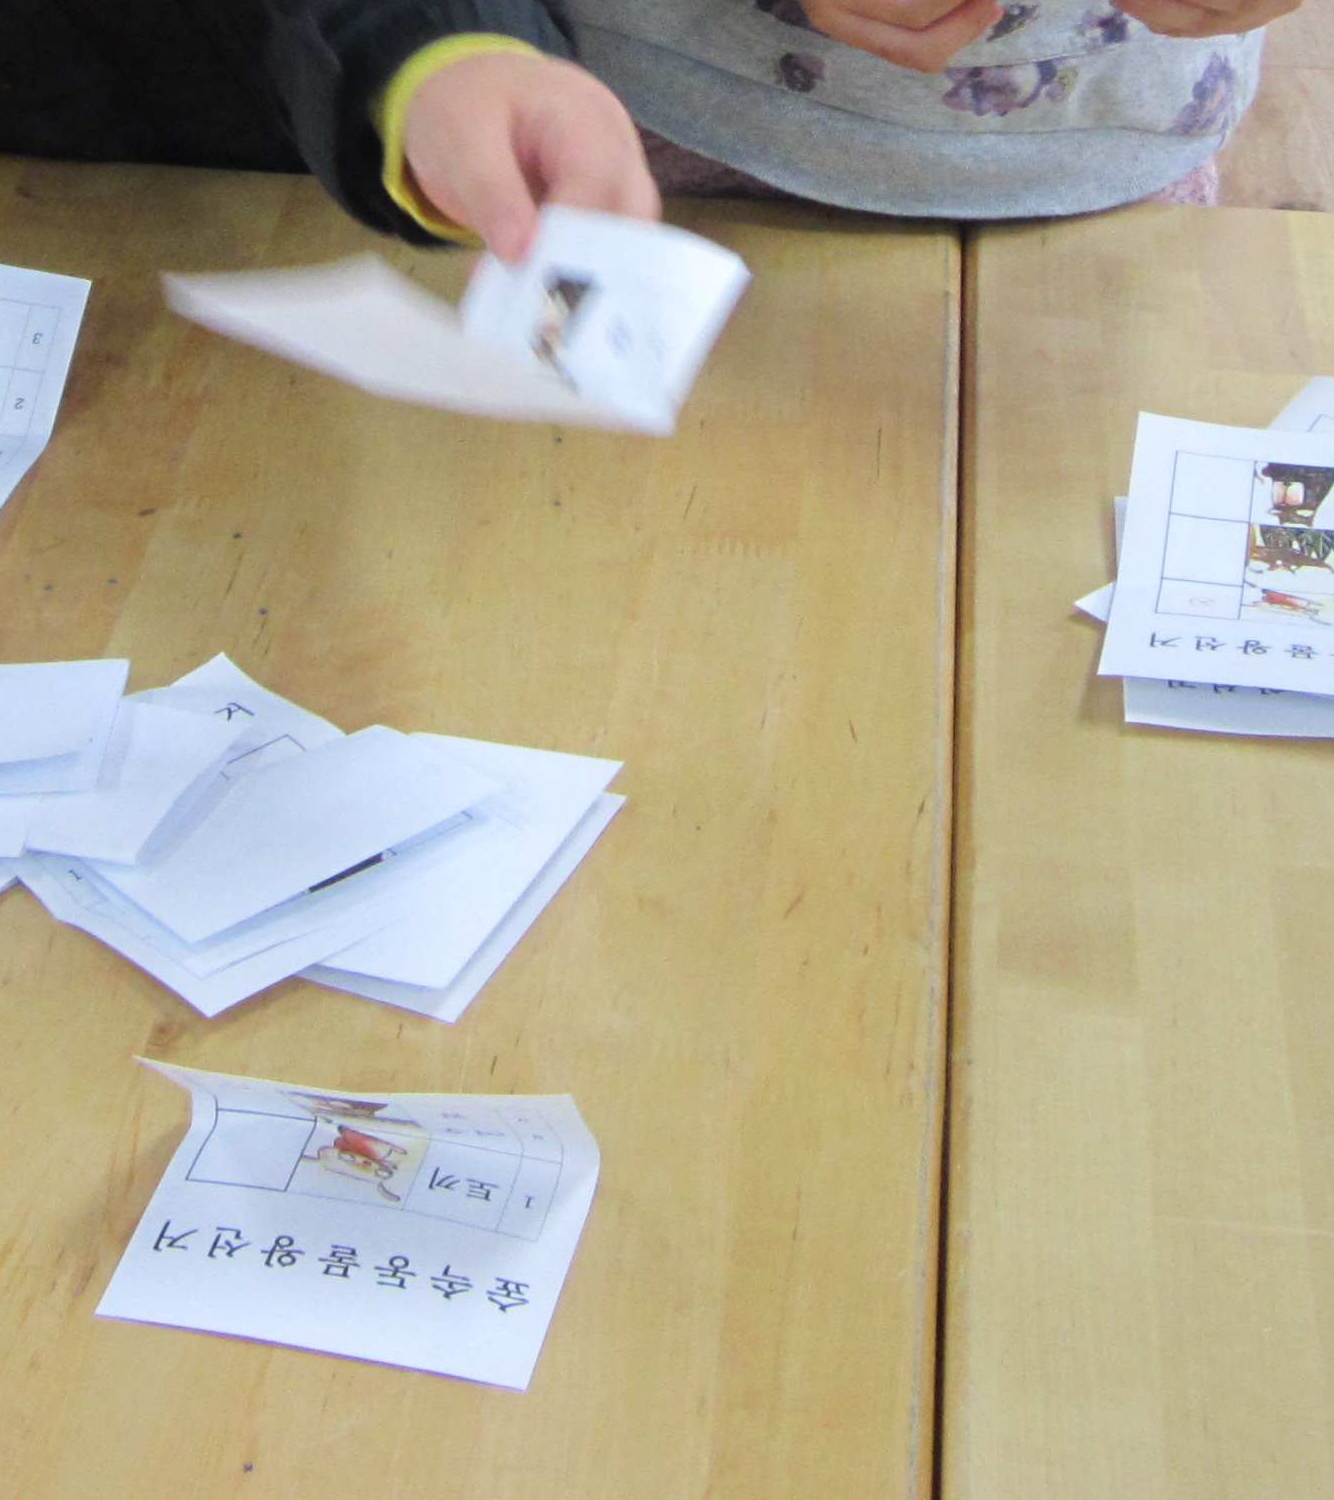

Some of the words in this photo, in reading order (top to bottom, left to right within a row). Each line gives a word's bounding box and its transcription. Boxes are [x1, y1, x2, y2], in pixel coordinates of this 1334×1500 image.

[32, 333, 43, 344] 3
[15, 398, 25, 409] 2
[428, 1167, 500, 1201] 토끼
[525, 1195, 535, 1208] 1
